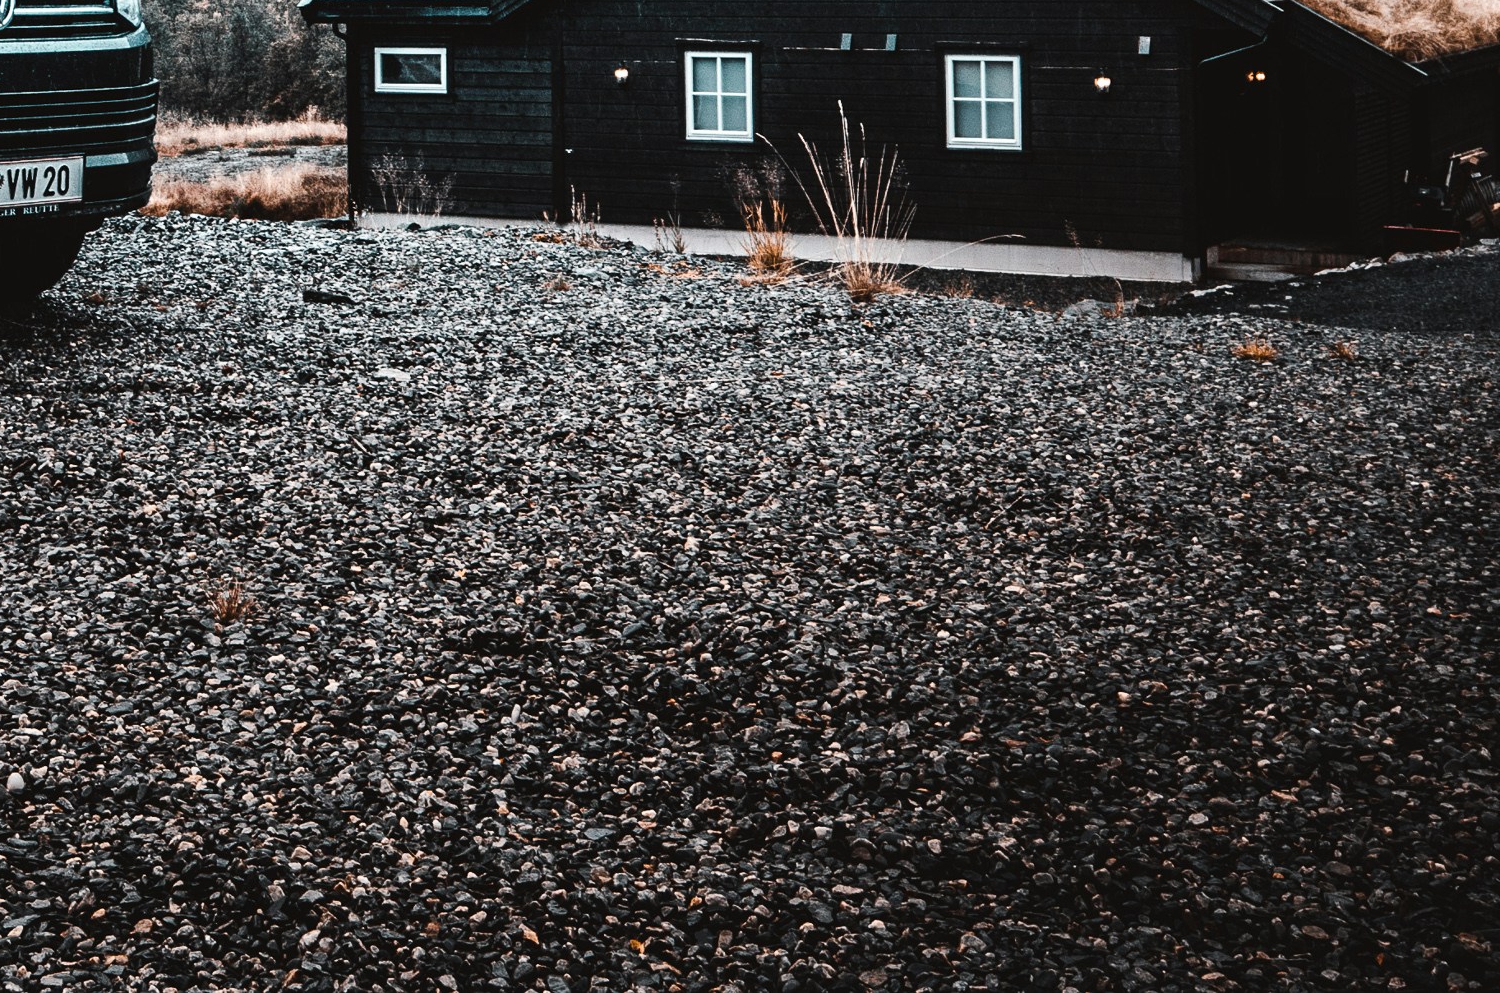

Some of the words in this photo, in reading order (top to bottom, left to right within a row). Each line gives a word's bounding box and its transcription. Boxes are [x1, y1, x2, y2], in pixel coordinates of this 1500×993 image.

[7, 167, 39, 200] VW
[43, 165, 69, 197] 20
[23, 204, 60, 215] REUTTE
